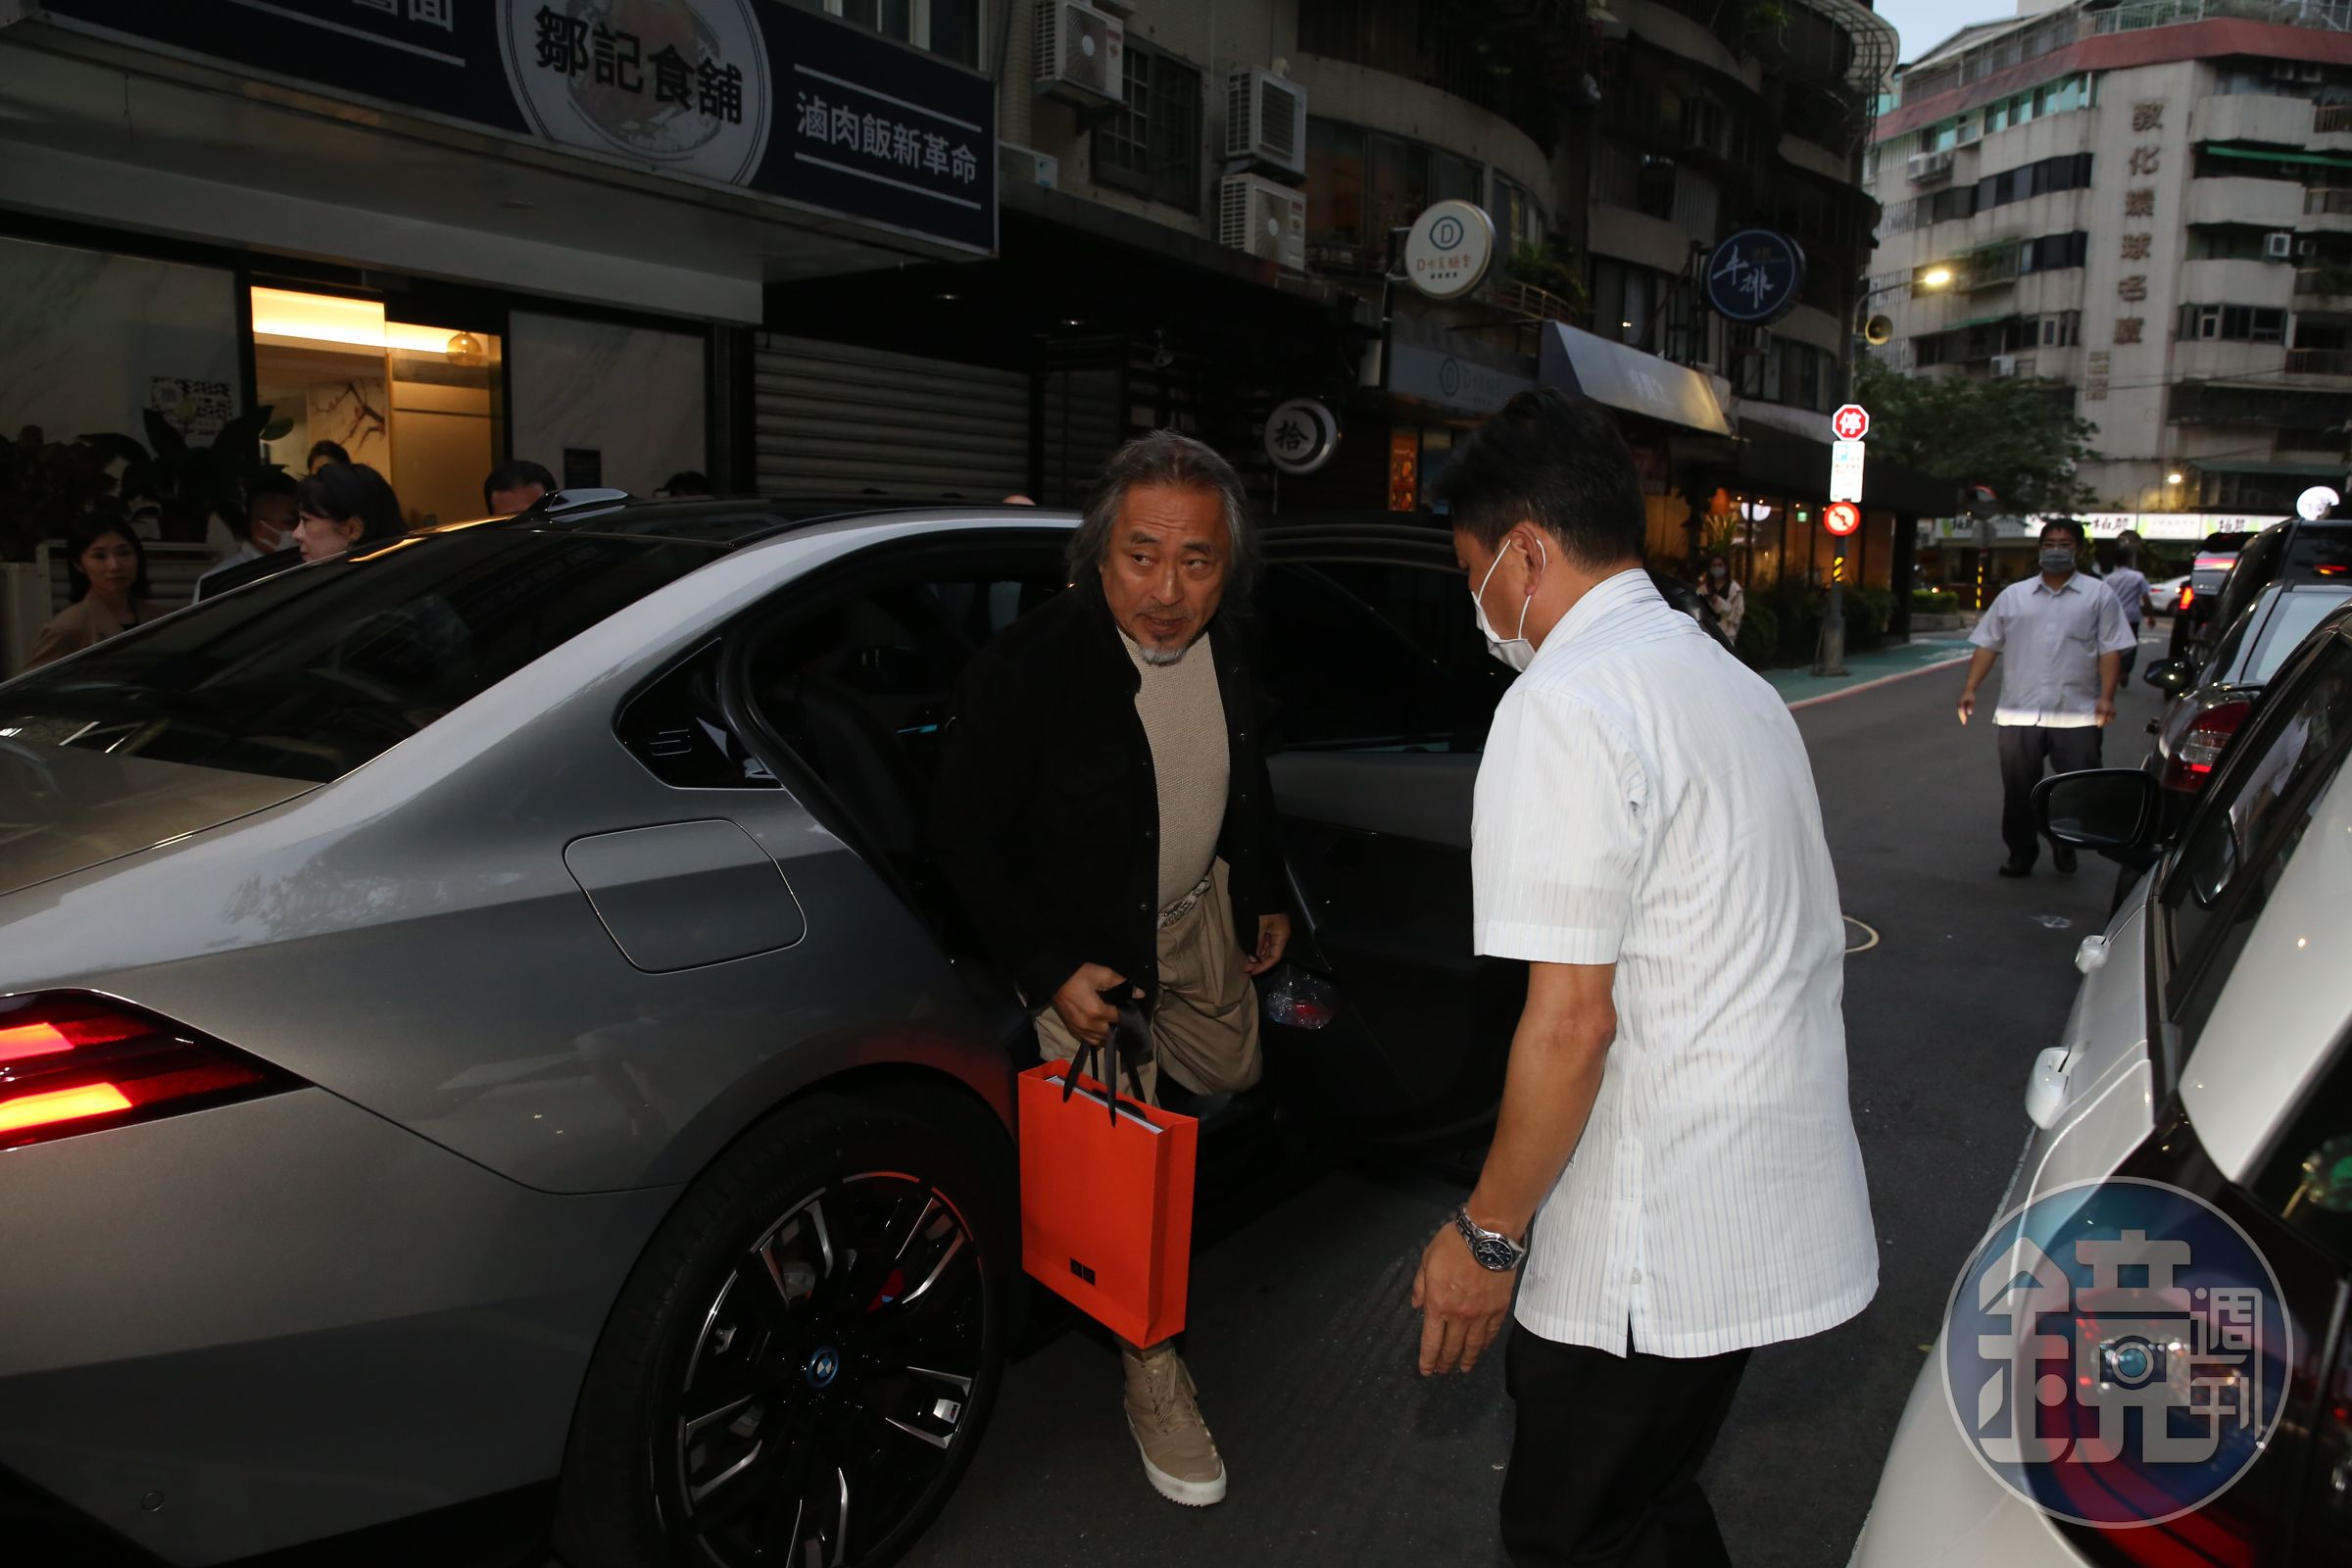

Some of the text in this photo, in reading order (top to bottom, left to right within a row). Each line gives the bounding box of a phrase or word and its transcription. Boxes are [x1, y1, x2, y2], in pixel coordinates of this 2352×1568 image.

[534, 5, 743, 124] 鄒記食舖
[795, 90, 978, 184] 滷肉飯新革命
[1274, 419, 1309, 452] 拾
[1839, 412, 1862, 435] 停
